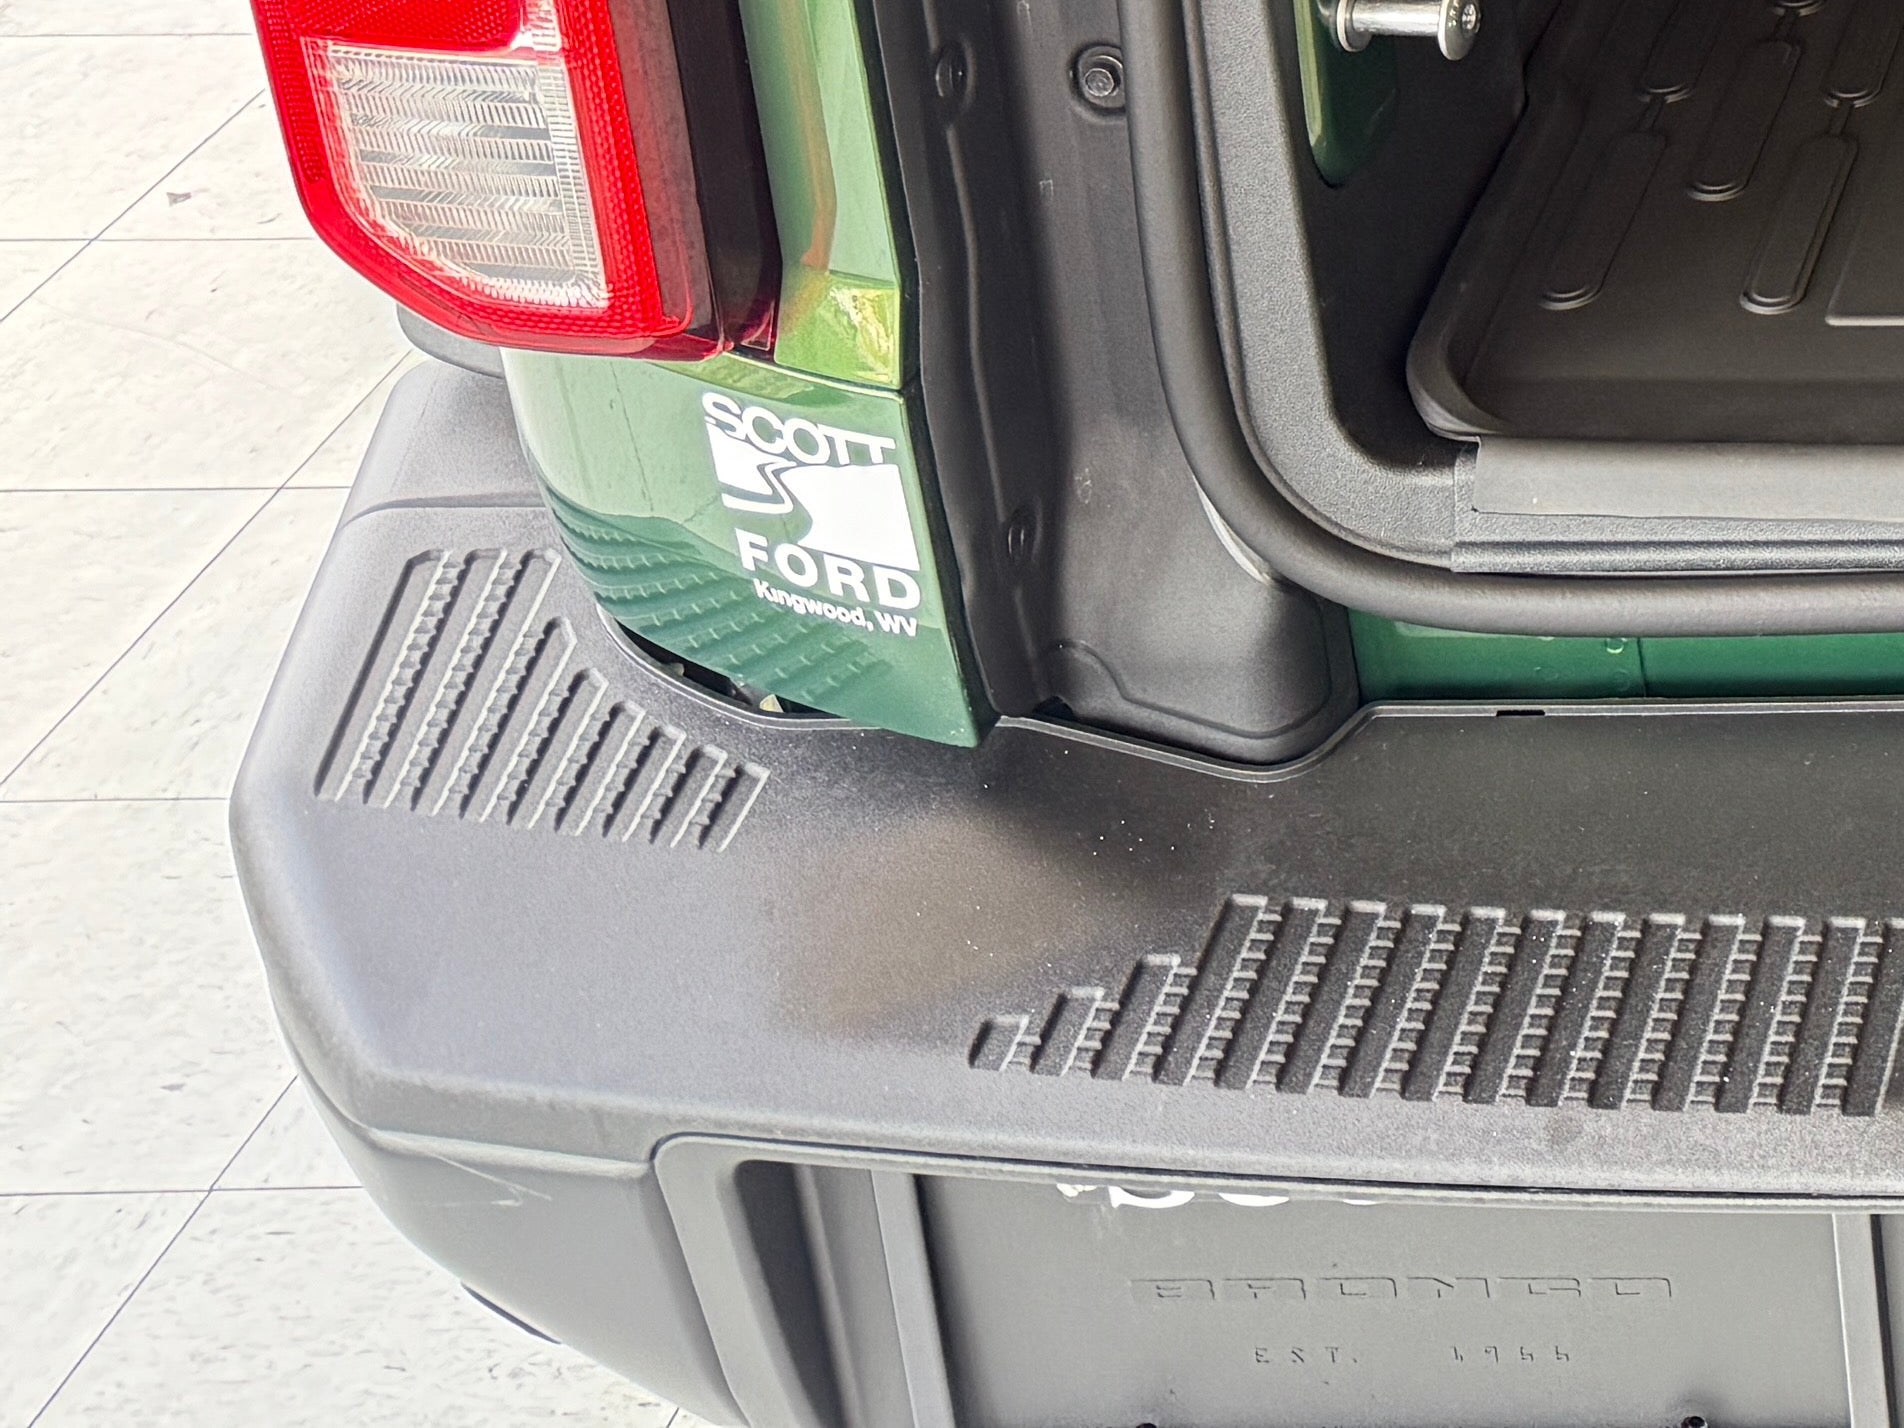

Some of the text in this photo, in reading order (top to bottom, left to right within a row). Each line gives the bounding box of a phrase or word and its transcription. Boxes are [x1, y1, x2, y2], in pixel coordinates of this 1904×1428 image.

[702, 392, 896, 465] SCOTT
[735, 528, 921, 610] FORD
[753, 578, 918, 637] Kingwood, WV
[1255, 1346, 1358, 1364] EST.
